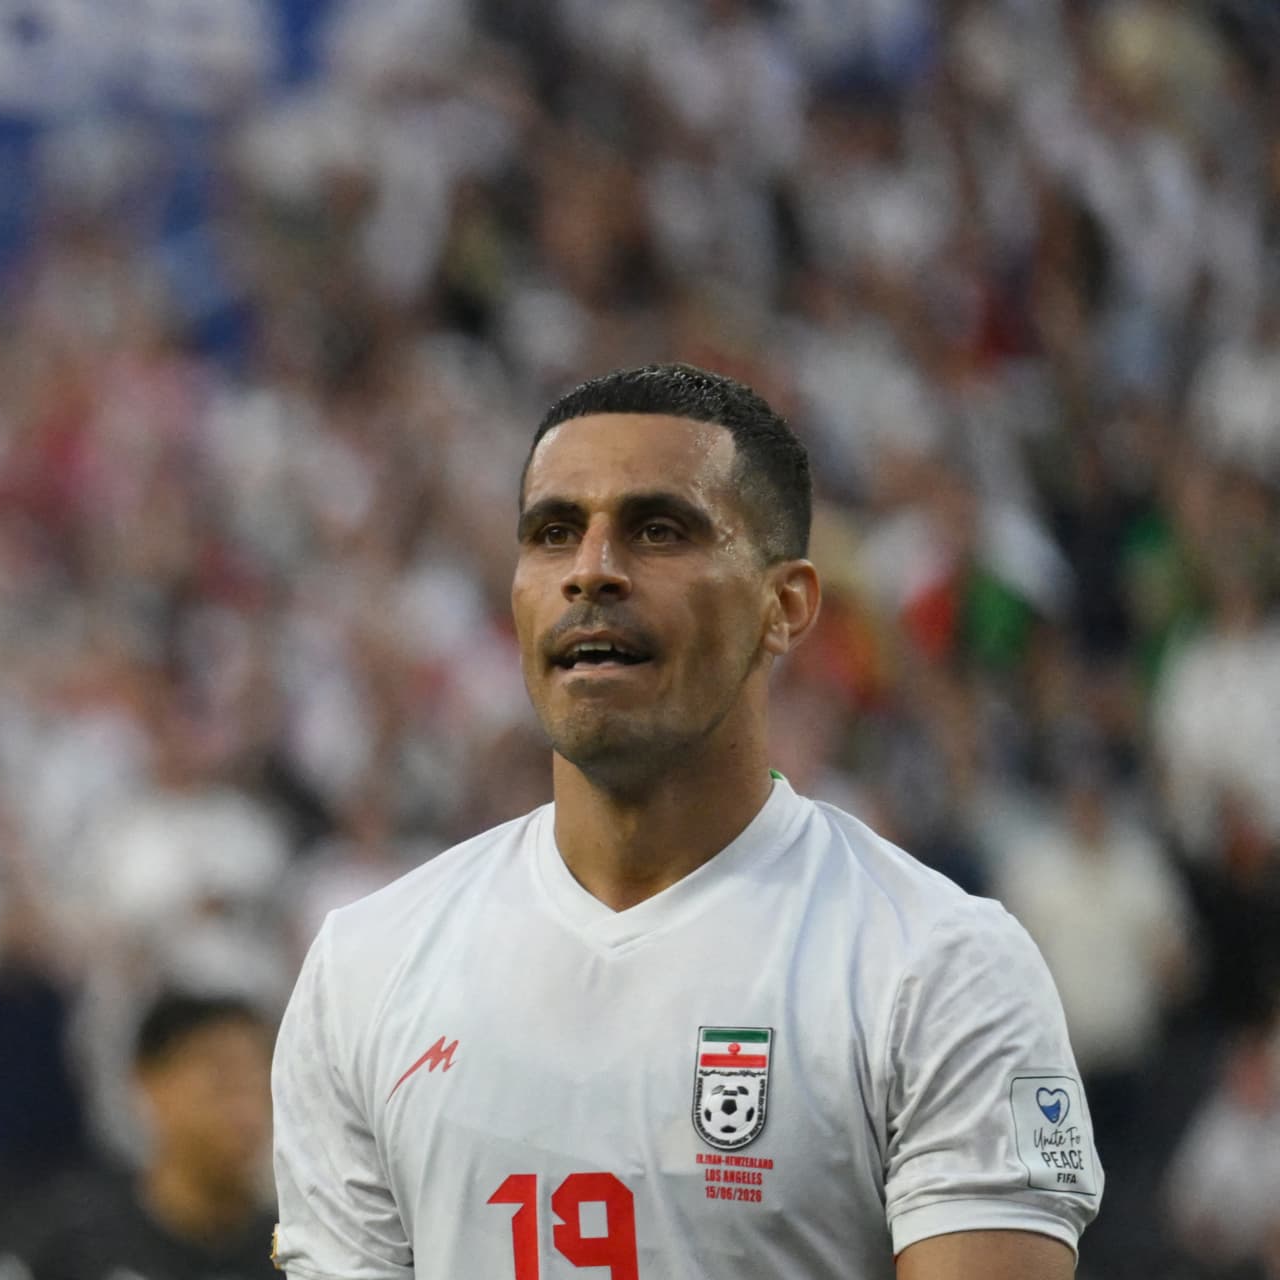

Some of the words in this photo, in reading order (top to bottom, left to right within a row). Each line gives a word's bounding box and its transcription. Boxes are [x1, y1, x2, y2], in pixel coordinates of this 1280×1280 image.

[1041, 1149, 1084, 1170] PEACE
[705, 1168, 721, 1182] LOS
[723, 1170, 763, 1186] ANGELES
[1056, 1172, 1077, 1184] FIFA
[705, 1186, 762, 1203] 15/06/2026
